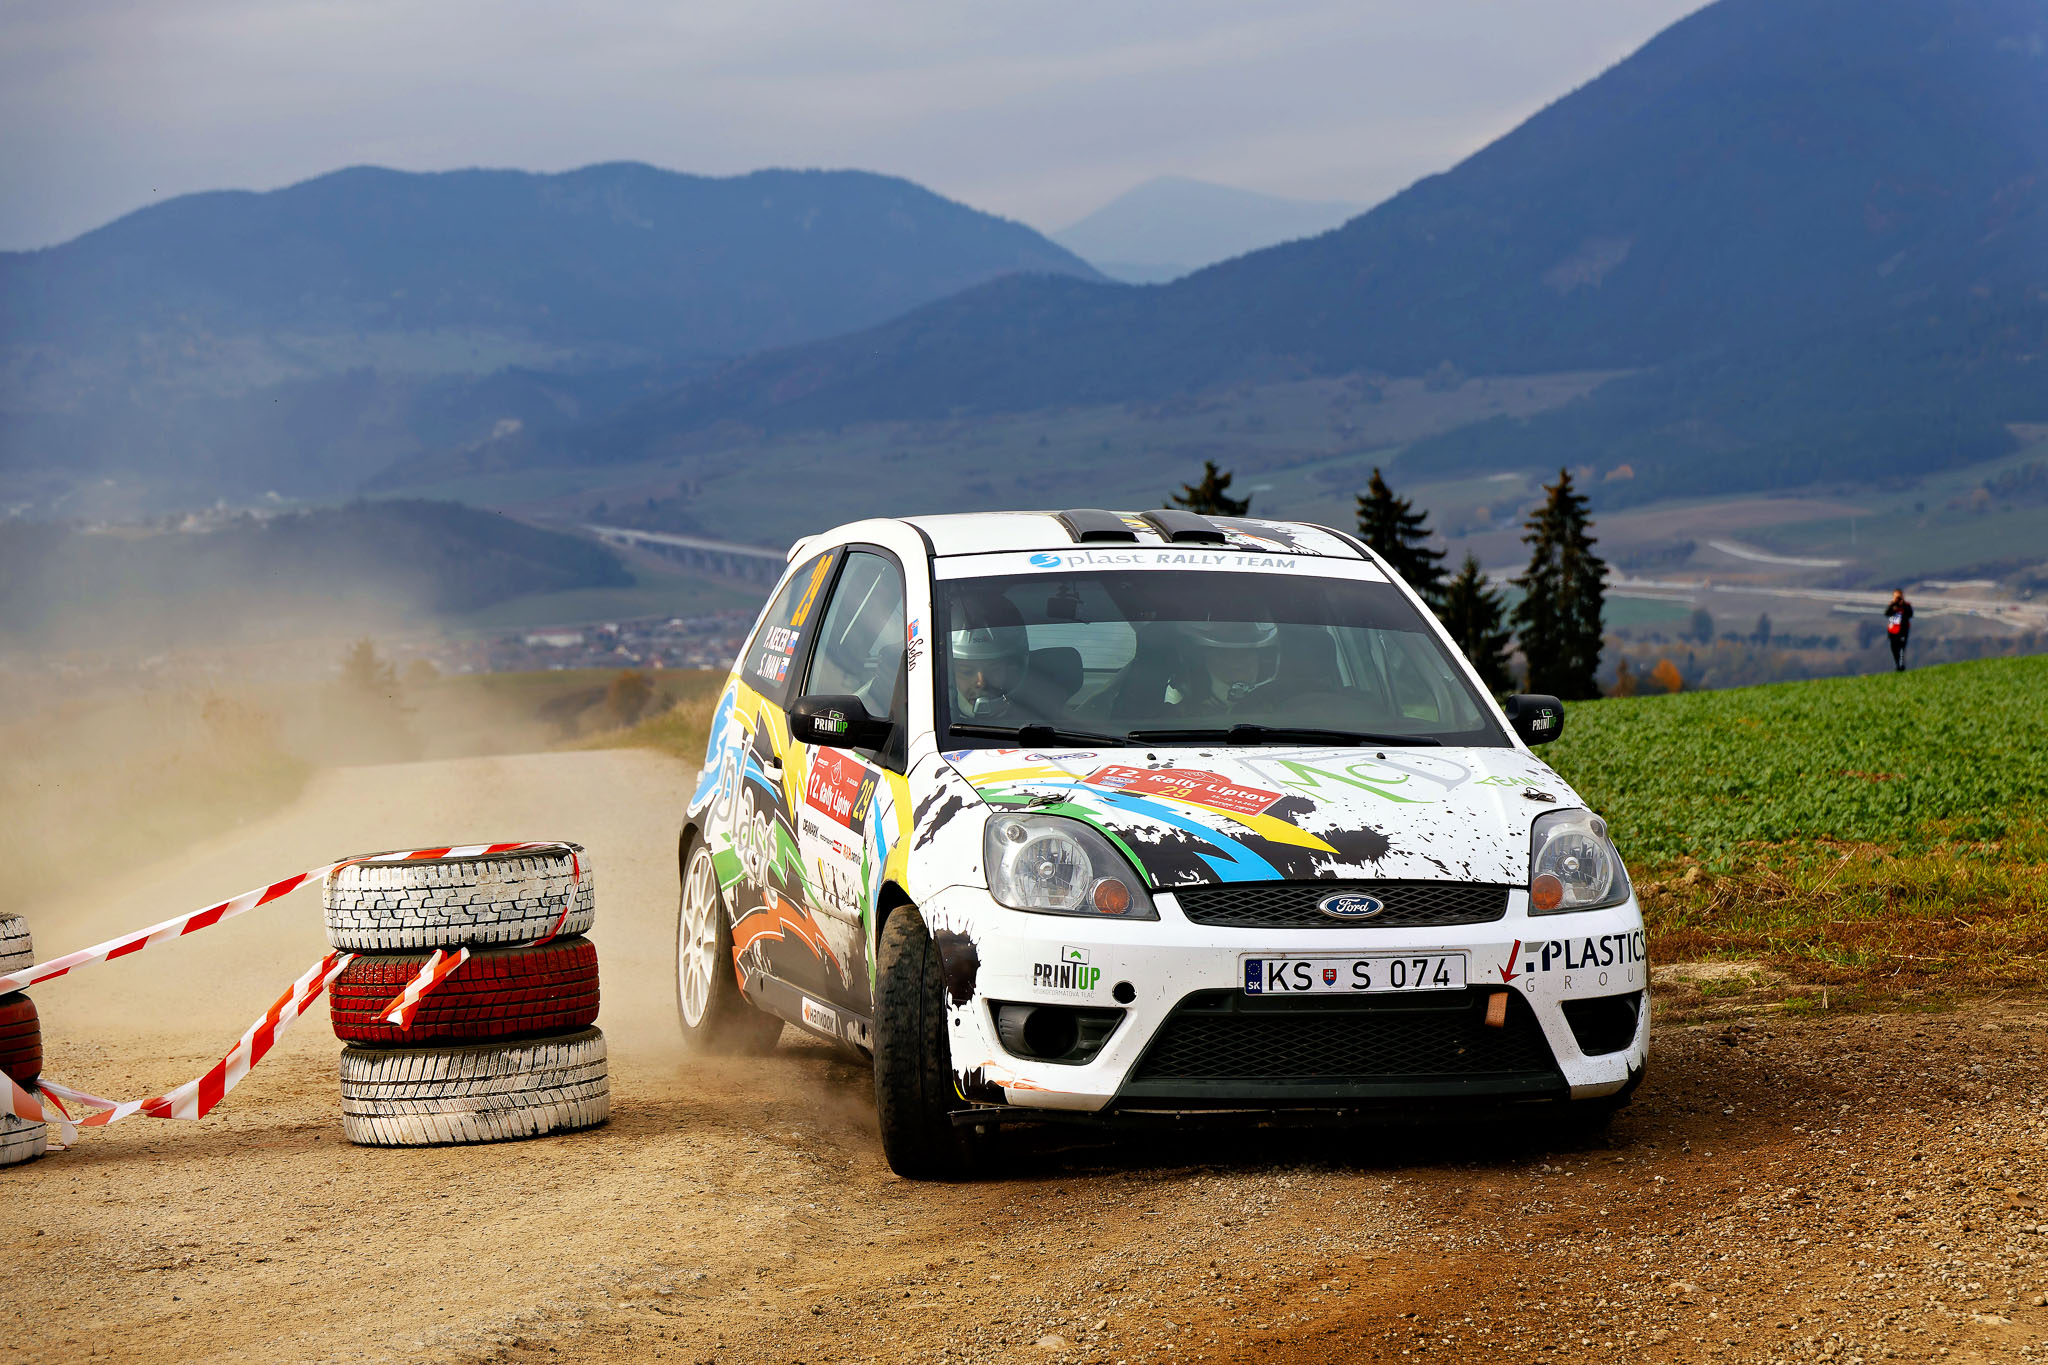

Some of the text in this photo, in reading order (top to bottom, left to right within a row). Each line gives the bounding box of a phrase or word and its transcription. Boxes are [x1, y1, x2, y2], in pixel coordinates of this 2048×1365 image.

[1157, 553, 1227, 565] RALLY
[1235, 556, 1296, 569] TEAM
[790, 554, 834, 627] 29
[814, 717, 848, 734] PRINTUP
[808, 771, 875, 822] 12. Rally Liptov 29
[1106, 767, 1141, 779] 12.
[1148, 774, 1203, 789] Rally
[1206, 784, 1273, 803] Liptov
[1157, 785, 1192, 798] 29
[1336, 898, 1369, 912] Ford
[1033, 962, 1101, 991] PRINTUP
[1248, 981, 1261, 990] SK
[1268, 958, 1450, 991] KS S 074
[1525, 966, 1646, 993] GROU
